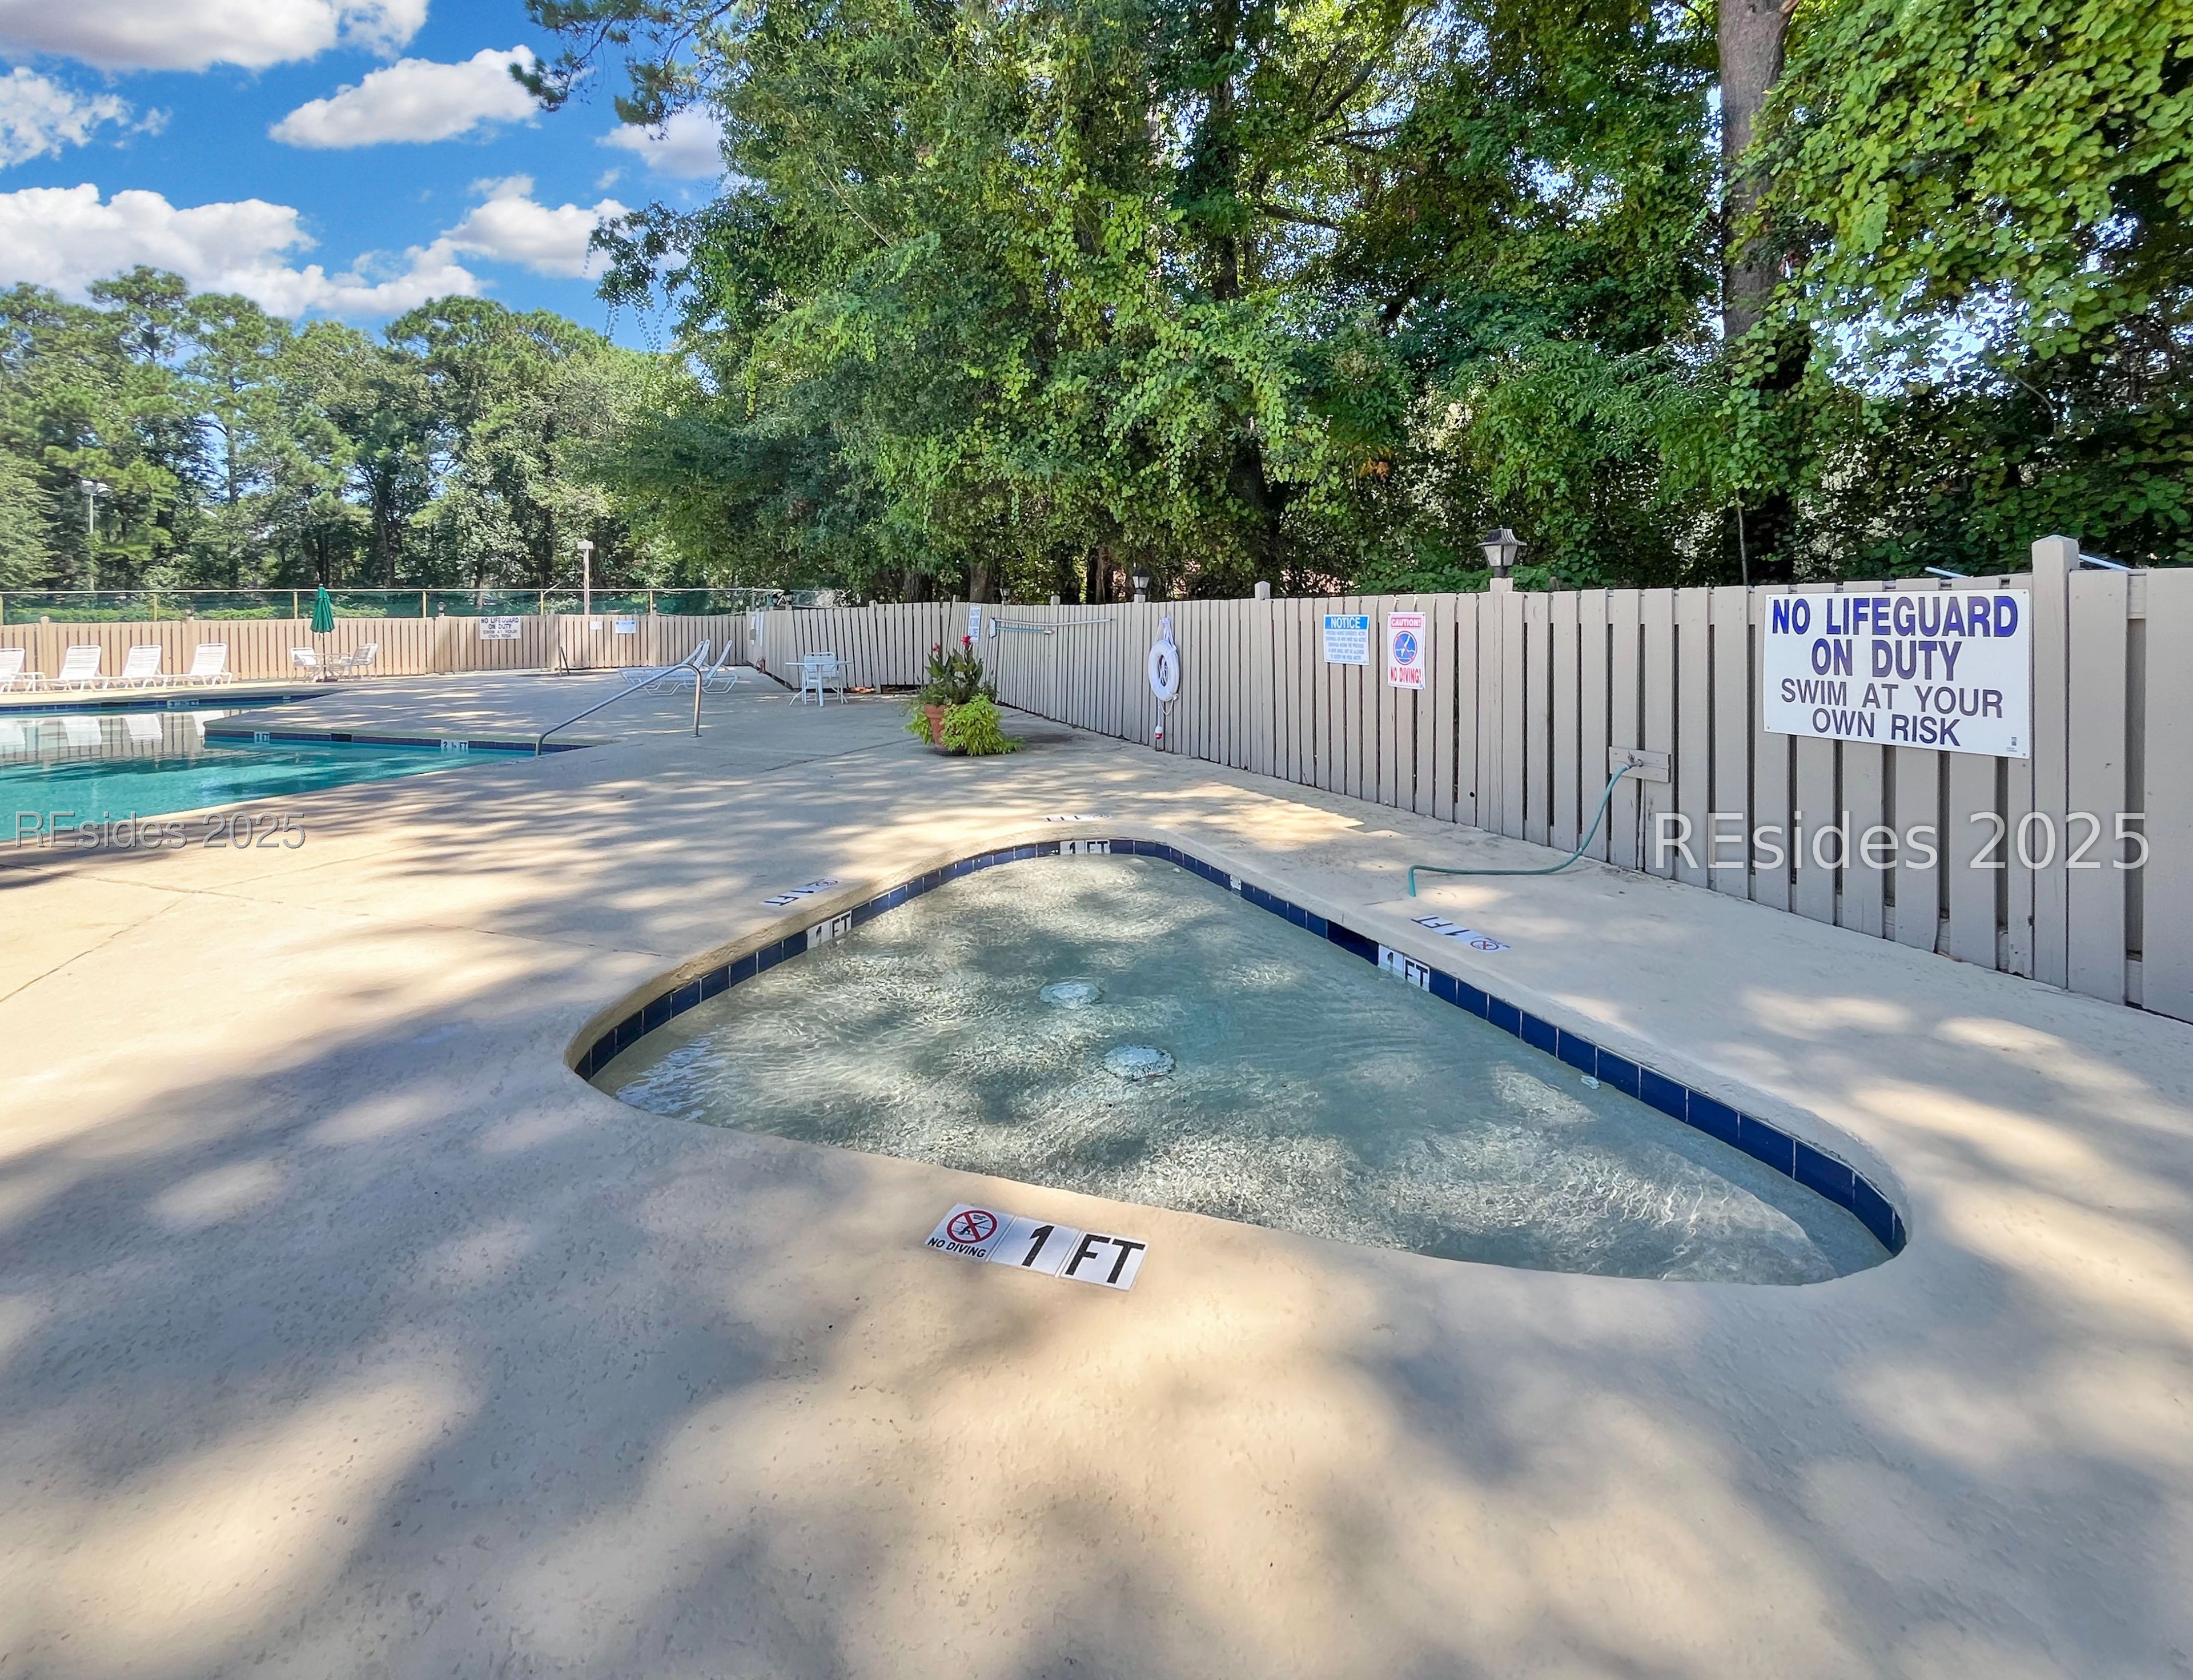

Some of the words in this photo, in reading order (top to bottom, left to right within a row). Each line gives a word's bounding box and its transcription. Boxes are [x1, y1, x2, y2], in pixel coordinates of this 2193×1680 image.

[1331, 617, 1361, 629] NOTICE
[1391, 618, 1421, 627] CAUTION!
[1772, 598, 1810, 634] NO
[1826, 596, 2018, 637] LIFEGUARD
[1812, 638, 1853, 676] ON
[1872, 640, 1962, 681] DUTY
[1391, 666, 1397, 681] NO
[1399, 667, 1421, 684] DIVING!
[1781, 678, 1847, 706] SWIM
[1862, 684, 1898, 710] AT
[1914, 685, 2003, 718] YOUR
[1812, 708, 1874, 738] OWN
[1891, 714, 1961, 746] RISK
[1069, 842, 1075, 854] 1
[1087, 841, 1108, 853] FT
[832, 913, 850, 938] FT
[1411, 917, 1453, 929] FT
[1405, 958, 1428, 987] FT
[927, 1237, 945, 1249] NO
[946, 1241, 987, 1258] DIVING
[1022, 1225, 1055, 1267] 1
[1065, 1233, 1146, 1284] FT
